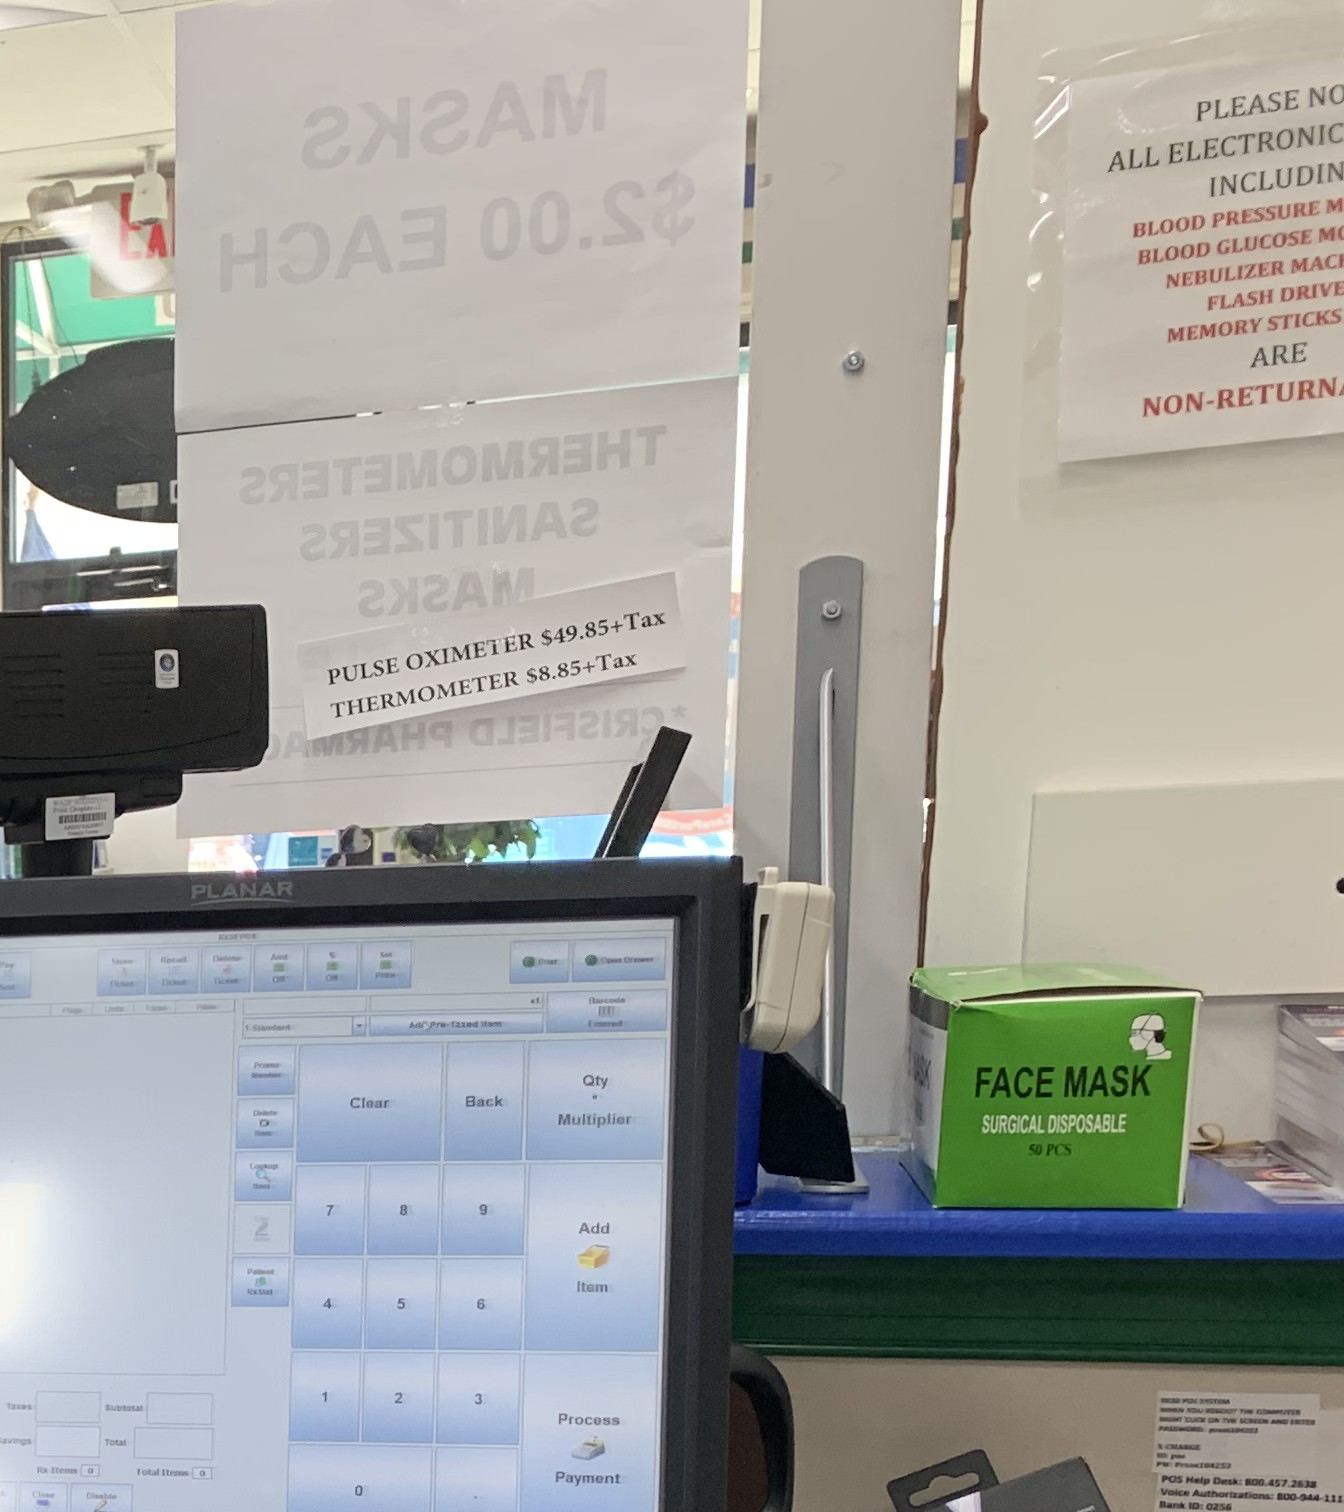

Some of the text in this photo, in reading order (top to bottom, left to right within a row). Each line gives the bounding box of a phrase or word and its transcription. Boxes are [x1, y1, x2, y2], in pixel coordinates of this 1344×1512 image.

[1196, 88, 1299, 122] PLEASE
[1107, 145, 1160, 173] ALL
[1132, 214, 1205, 239] BLOOD
[1212, 199, 1320, 229] PRESSURE
[1137, 240, 1211, 266] BLOOD
[1216, 229, 1312, 257] GLUCOSE
[1166, 260, 1285, 289] NEBULIZER
[1207, 289, 1273, 312] FLASH
[1167, 308, 1342, 344] MEMORY STICKS
[1250, 340, 1308, 369] ARE
[326, 608, 667, 686] PULSE OXIMETER $49.85+Tax
[329, 650, 639, 719] THERMOMETER $8.85+Tax
[191, 880, 293, 899] PLANAR
[582, 1074, 609, 1088] Qty
[974, 1065, 1153, 1099] FACE MASK
[349, 1096, 390, 1110] Clear
[465, 1095, 503, 1108] Back
[557, 1112, 633, 1127] Multiplier
[981, 1113, 1128, 1135] SURGICAL DISPOSABLE
[1028, 1143, 1072, 1157] 50 PCS
[325, 1204, 335, 1217] 7
[399, 1204, 409, 1217] 8
[478, 1204, 488, 1216] 9
[578, 1221, 611, 1236] Add
[576, 1281, 609, 1294] Item
[322, 1298, 333, 1310] 4
[396, 1298, 406, 1310] 5
[476, 1298, 486, 1310] 6
[394, 1391, 404, 1404] 2
[474, 1393, 483, 1405] 3
[557, 1413, 621, 1427] Process
[105, 1438, 127, 1447] Total
[555, 1472, 621, 1486] Payment
[1161, 1474, 1183, 1484] POS
[1186, 1475, 1211, 1487] Help
[354, 1484, 364, 1497] 0
[1160, 1487, 1190, 1498] Voice
[1158, 1500, 1185, 1510] Bank
